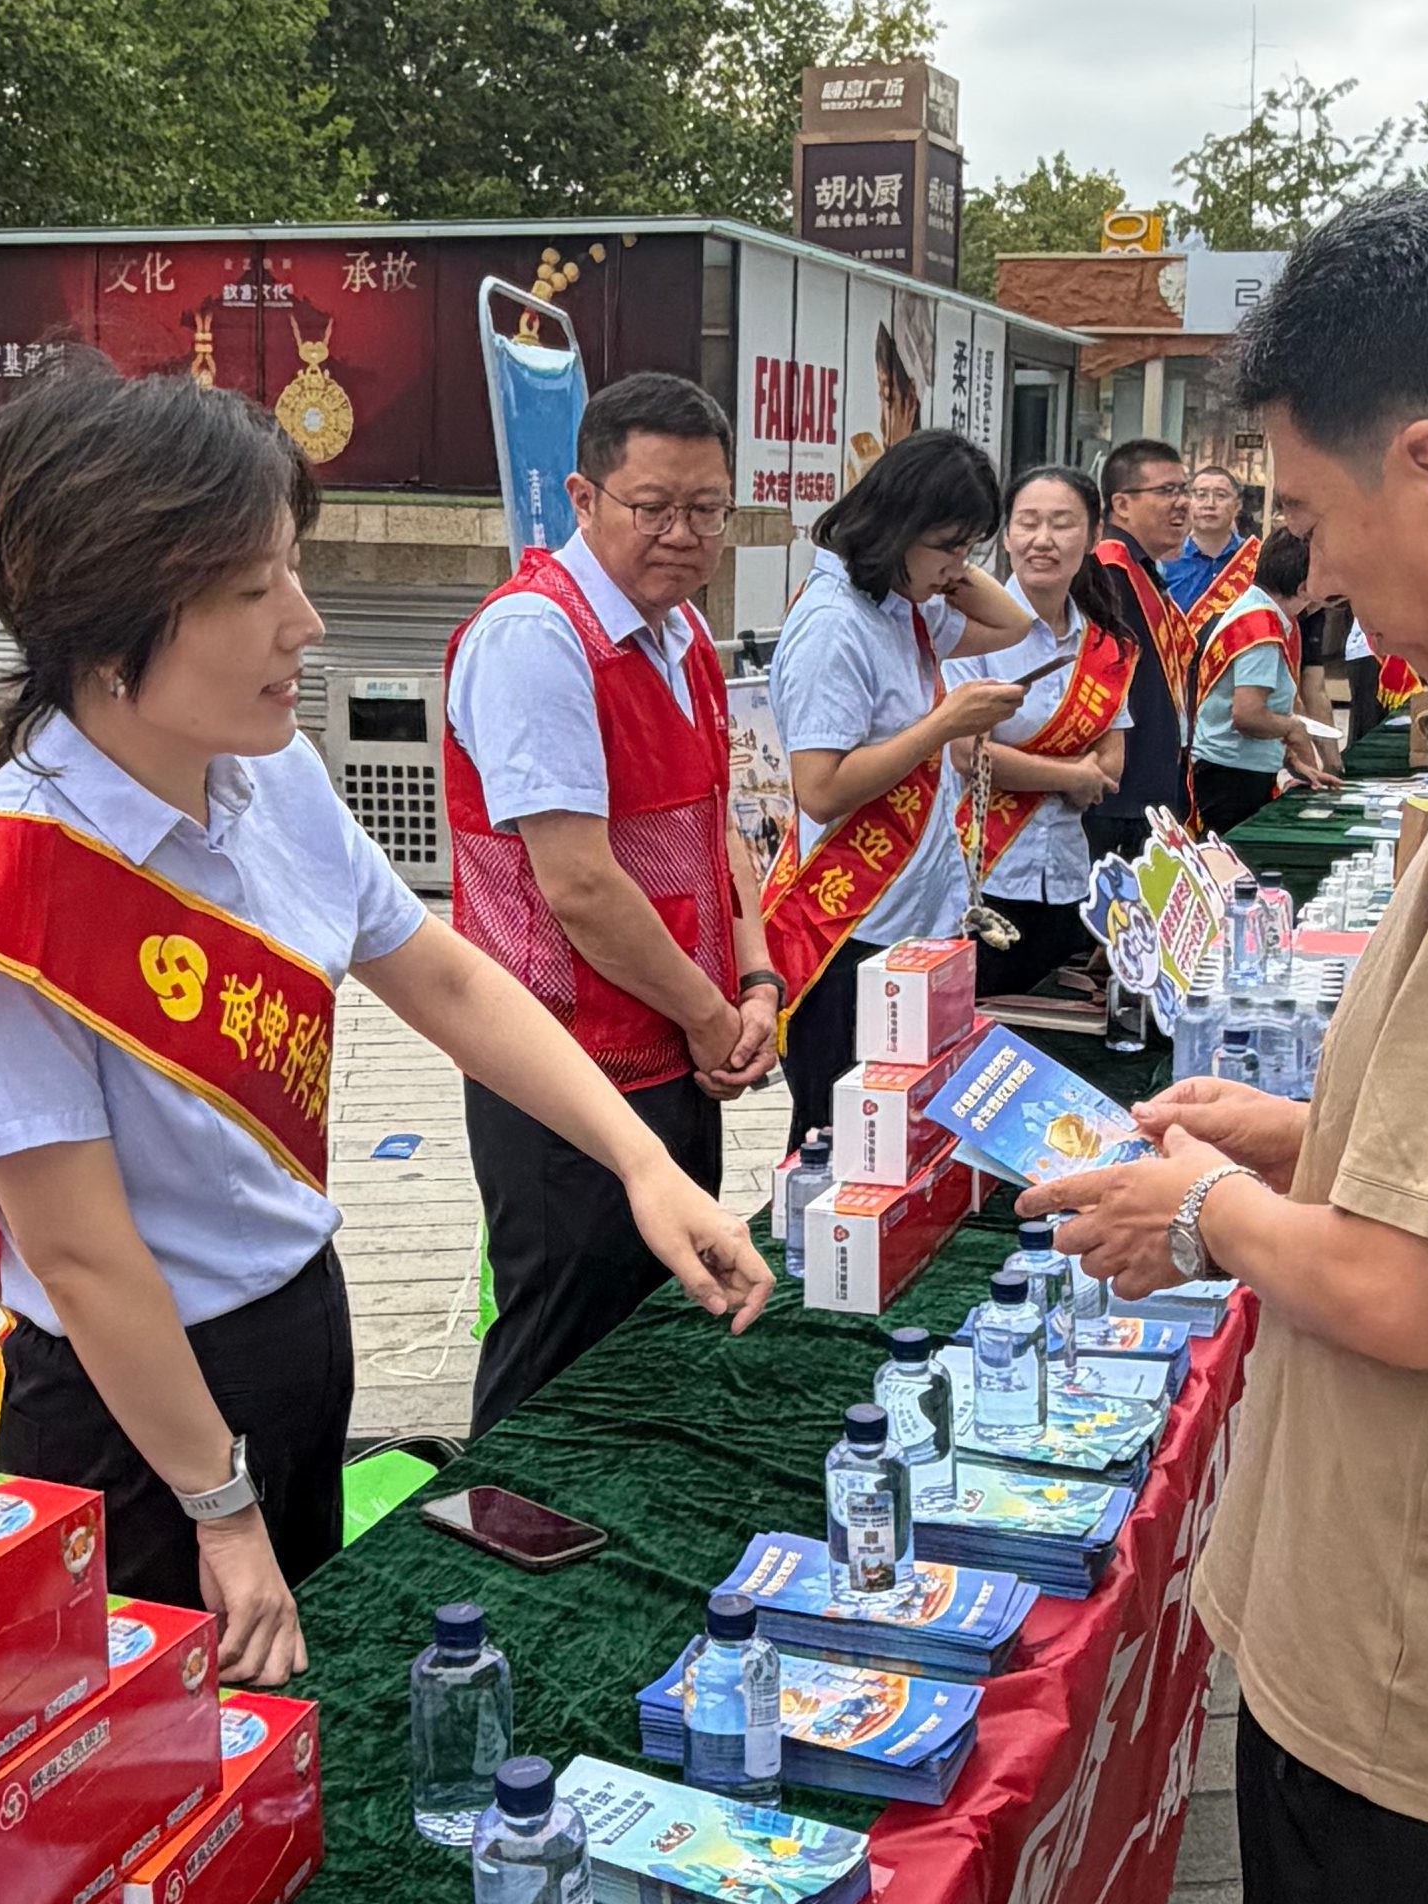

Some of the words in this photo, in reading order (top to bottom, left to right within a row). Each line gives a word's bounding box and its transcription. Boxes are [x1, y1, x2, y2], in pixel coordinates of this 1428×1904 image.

[814, 173, 903, 210] 胡小厨
[104, 251, 176, 295] 文化
[341, 250, 418, 293] 承故
[753, 355, 839, 445] FADAJE
